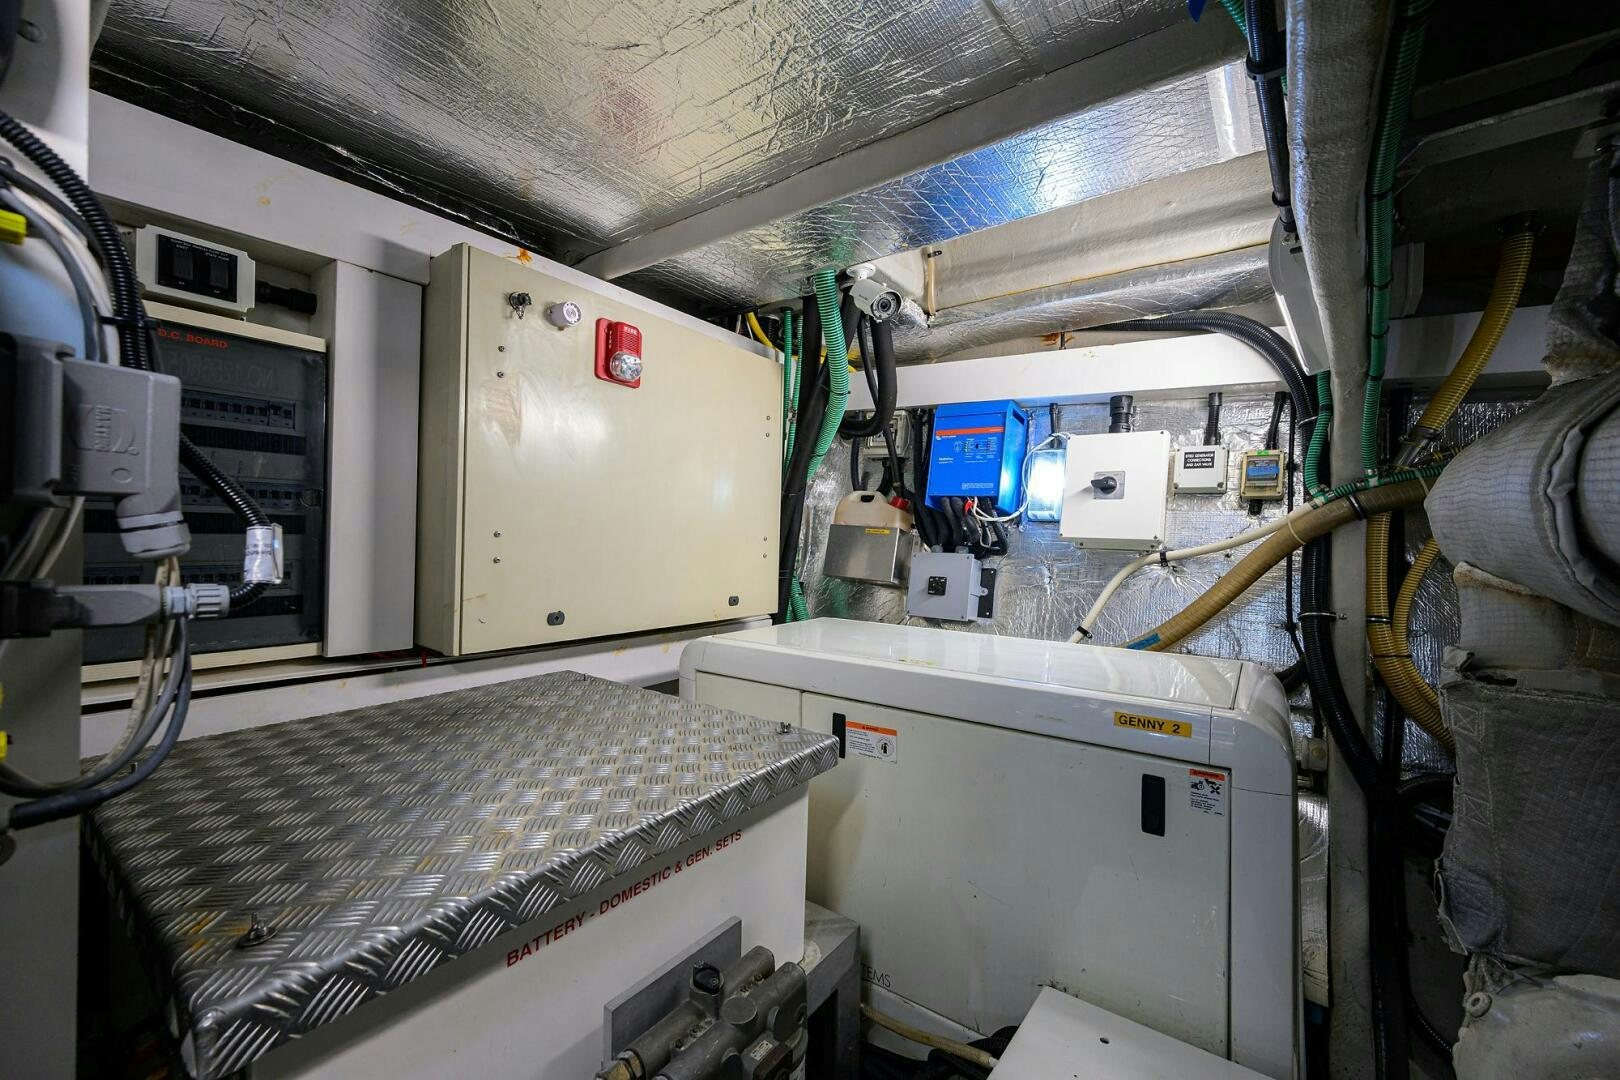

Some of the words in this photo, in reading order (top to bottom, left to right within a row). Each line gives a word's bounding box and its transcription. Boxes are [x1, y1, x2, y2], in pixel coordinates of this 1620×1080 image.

[186, 334, 229, 350] BOARD
[1118, 714, 1165, 731] GENNY
[1172, 723, 1181, 734] 2
[507, 910, 586, 968] BATTERY
[599, 866, 671, 916] DOMESTIC
[674, 860, 682, 874] &
[686, 847, 713, 868] GEN.
[716, 829, 742, 851] SETS
